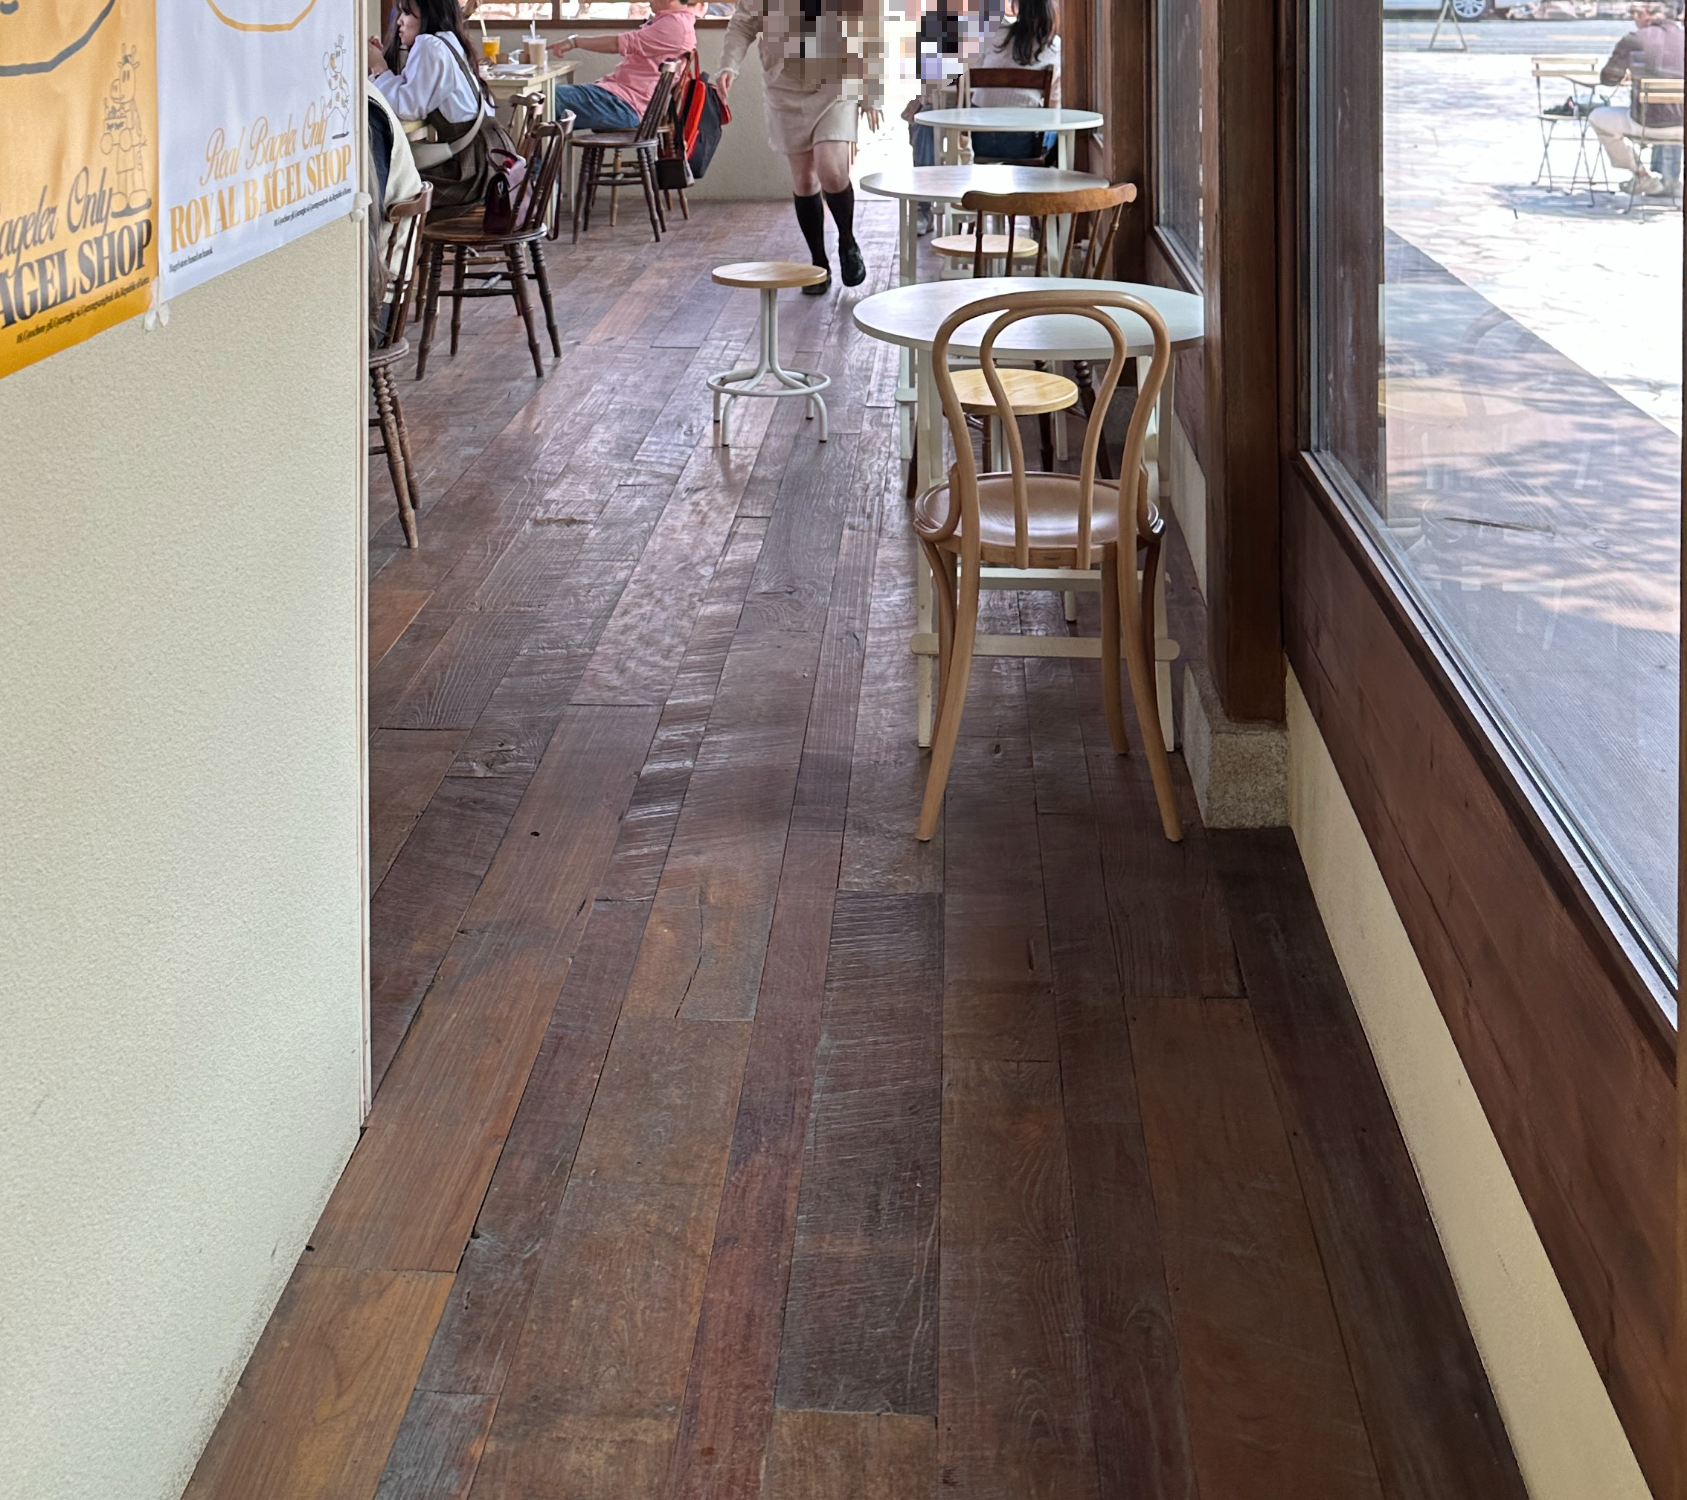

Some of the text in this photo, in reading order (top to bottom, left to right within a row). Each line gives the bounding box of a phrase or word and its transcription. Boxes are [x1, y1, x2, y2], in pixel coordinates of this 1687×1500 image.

[199, 126, 246, 187] Real
[66, 165, 114, 236] Only
[169, 184, 241, 255] ROYAL
[243, 160, 307, 224] BAGEL
[306, 144, 352, 196] SHOP
[77, 218, 153, 296] SHOP
